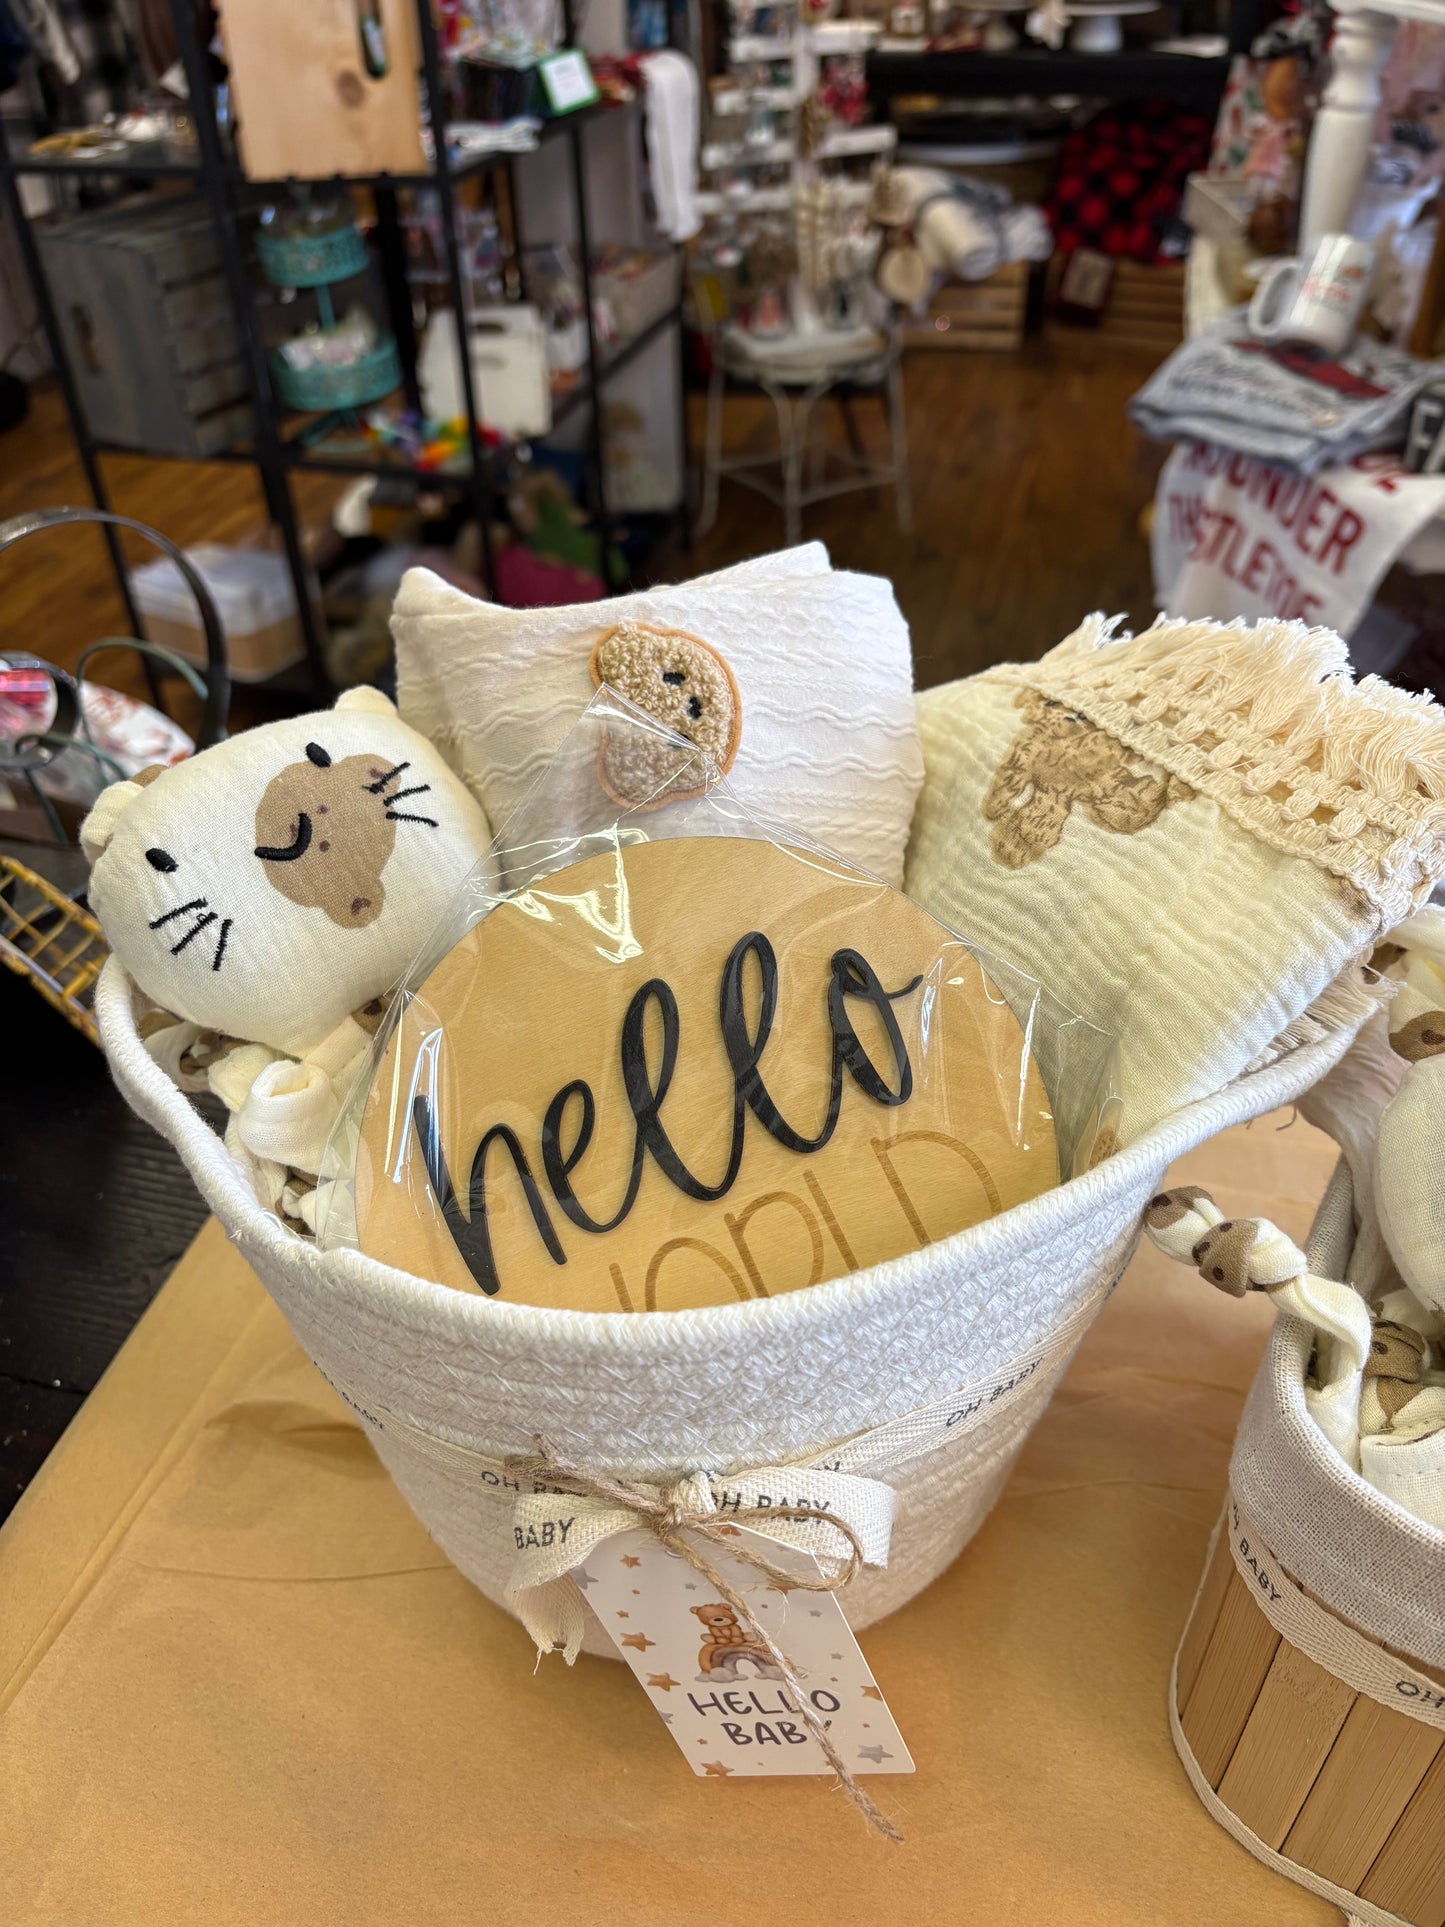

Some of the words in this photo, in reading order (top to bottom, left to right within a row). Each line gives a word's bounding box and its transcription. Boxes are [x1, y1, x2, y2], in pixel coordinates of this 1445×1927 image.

[414, 931, 923, 1296] hello
[945, 1398, 982, 1427] OH
[989, 1357, 1043, 1402] BABY
[481, 1470, 520, 1491] OH
[513, 1516, 576, 1550] BABY
[1239, 1536, 1282, 1601] BABY
[687, 1689, 841, 1717] HELLO
[720, 1719, 832, 1746] BAB
